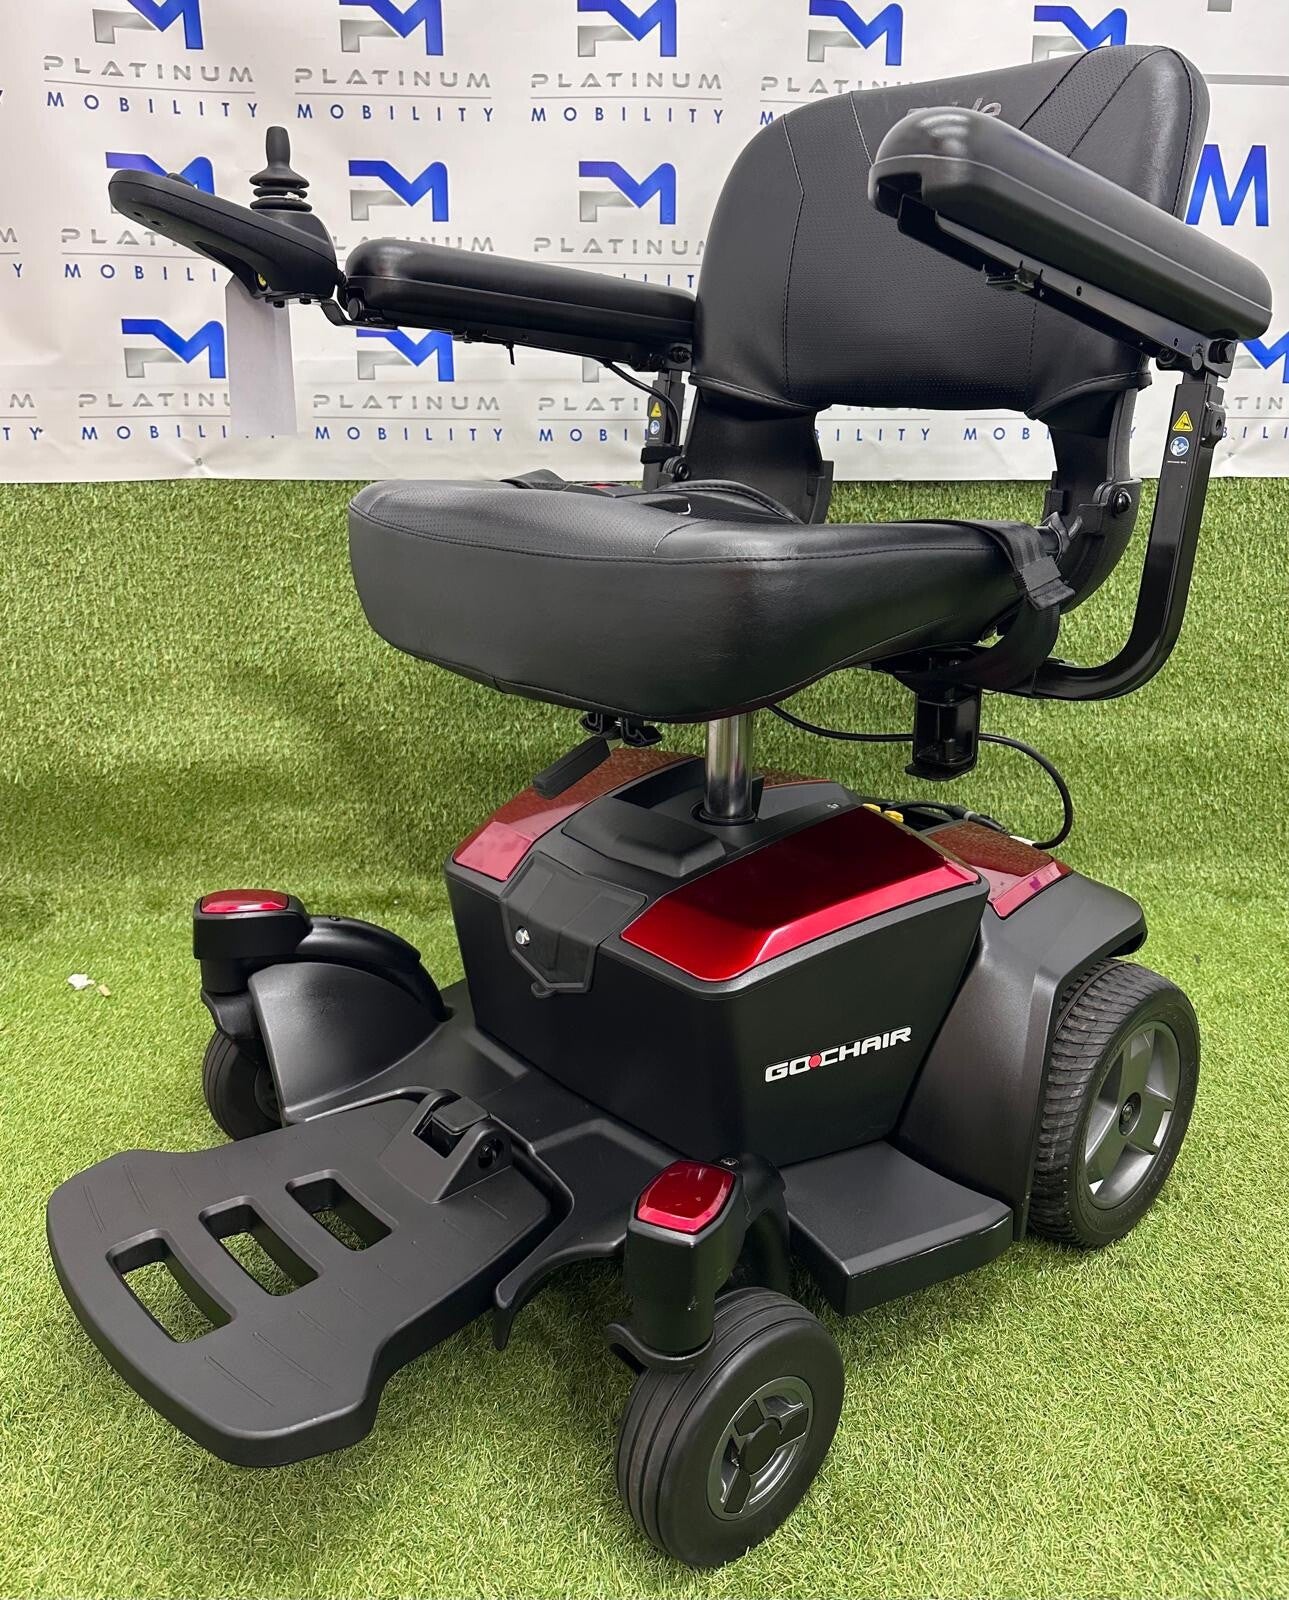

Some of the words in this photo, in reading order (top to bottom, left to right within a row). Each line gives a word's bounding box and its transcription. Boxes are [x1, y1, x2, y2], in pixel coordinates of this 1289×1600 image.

[44, 55, 254, 83] PLATINUM
[295, 67, 491, 88] PLATINUM
[531, 72, 722, 90] PLATINUM
[761, 76, 913, 94] PLATI
[47, 91, 258, 118] MOBILITY
[297, 103, 494, 122] MOBILITY
[531, 106, 723, 123] MOBILITY
[61, 228, 178, 247] PLAT
[65, 263, 216, 282] MOBILI
[313, 394, 500, 411] PLATINUM
[315, 426, 503, 442] MOBILITY
